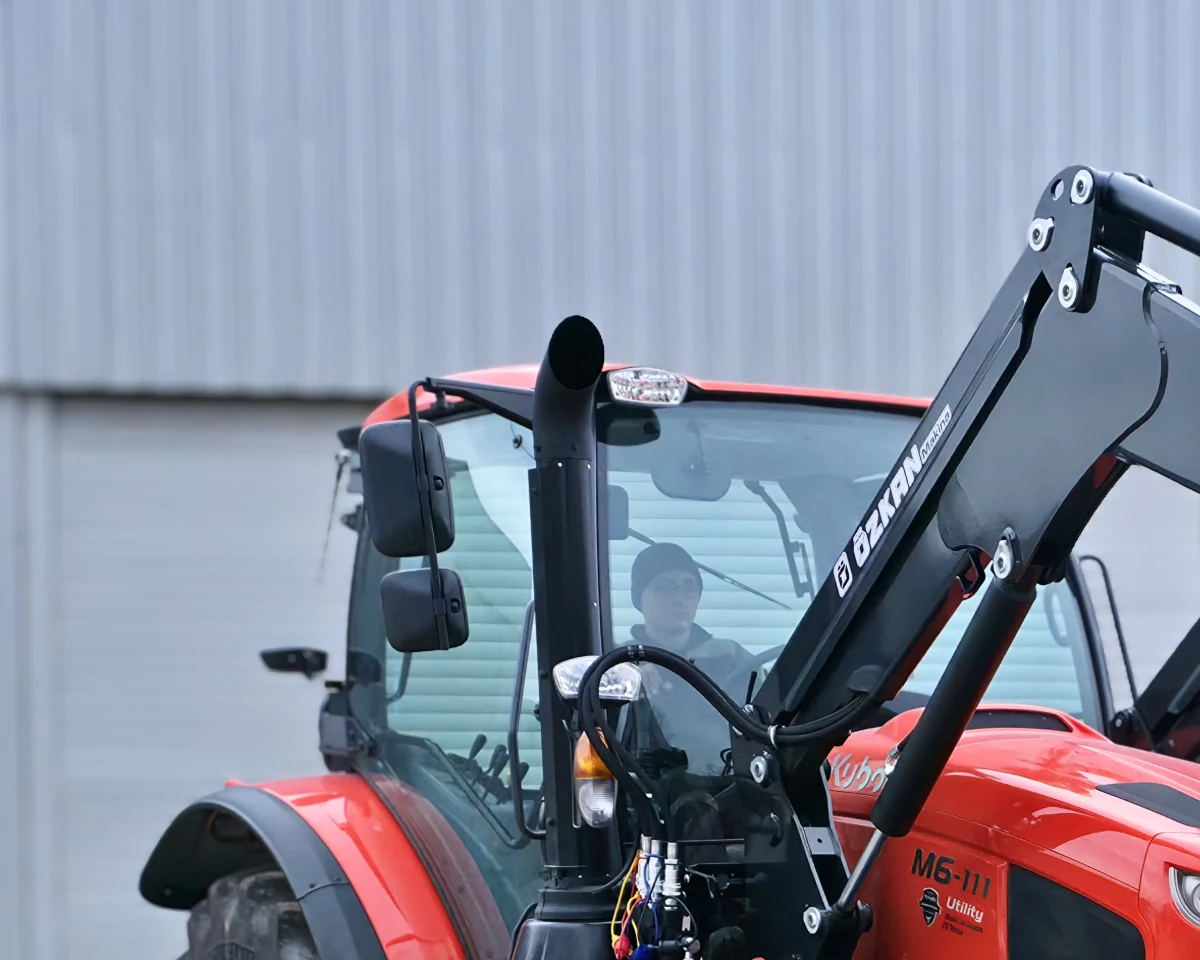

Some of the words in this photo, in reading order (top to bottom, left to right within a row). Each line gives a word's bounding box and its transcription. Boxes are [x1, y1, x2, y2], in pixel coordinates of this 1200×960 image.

[853, 444, 923, 568] ÖZKAN
[921, 410, 951, 460] Makina
[831, 752, 886, 793] Kubo
[911, 848, 991, 898] M6-111
[946, 896, 984, 923] Utility
